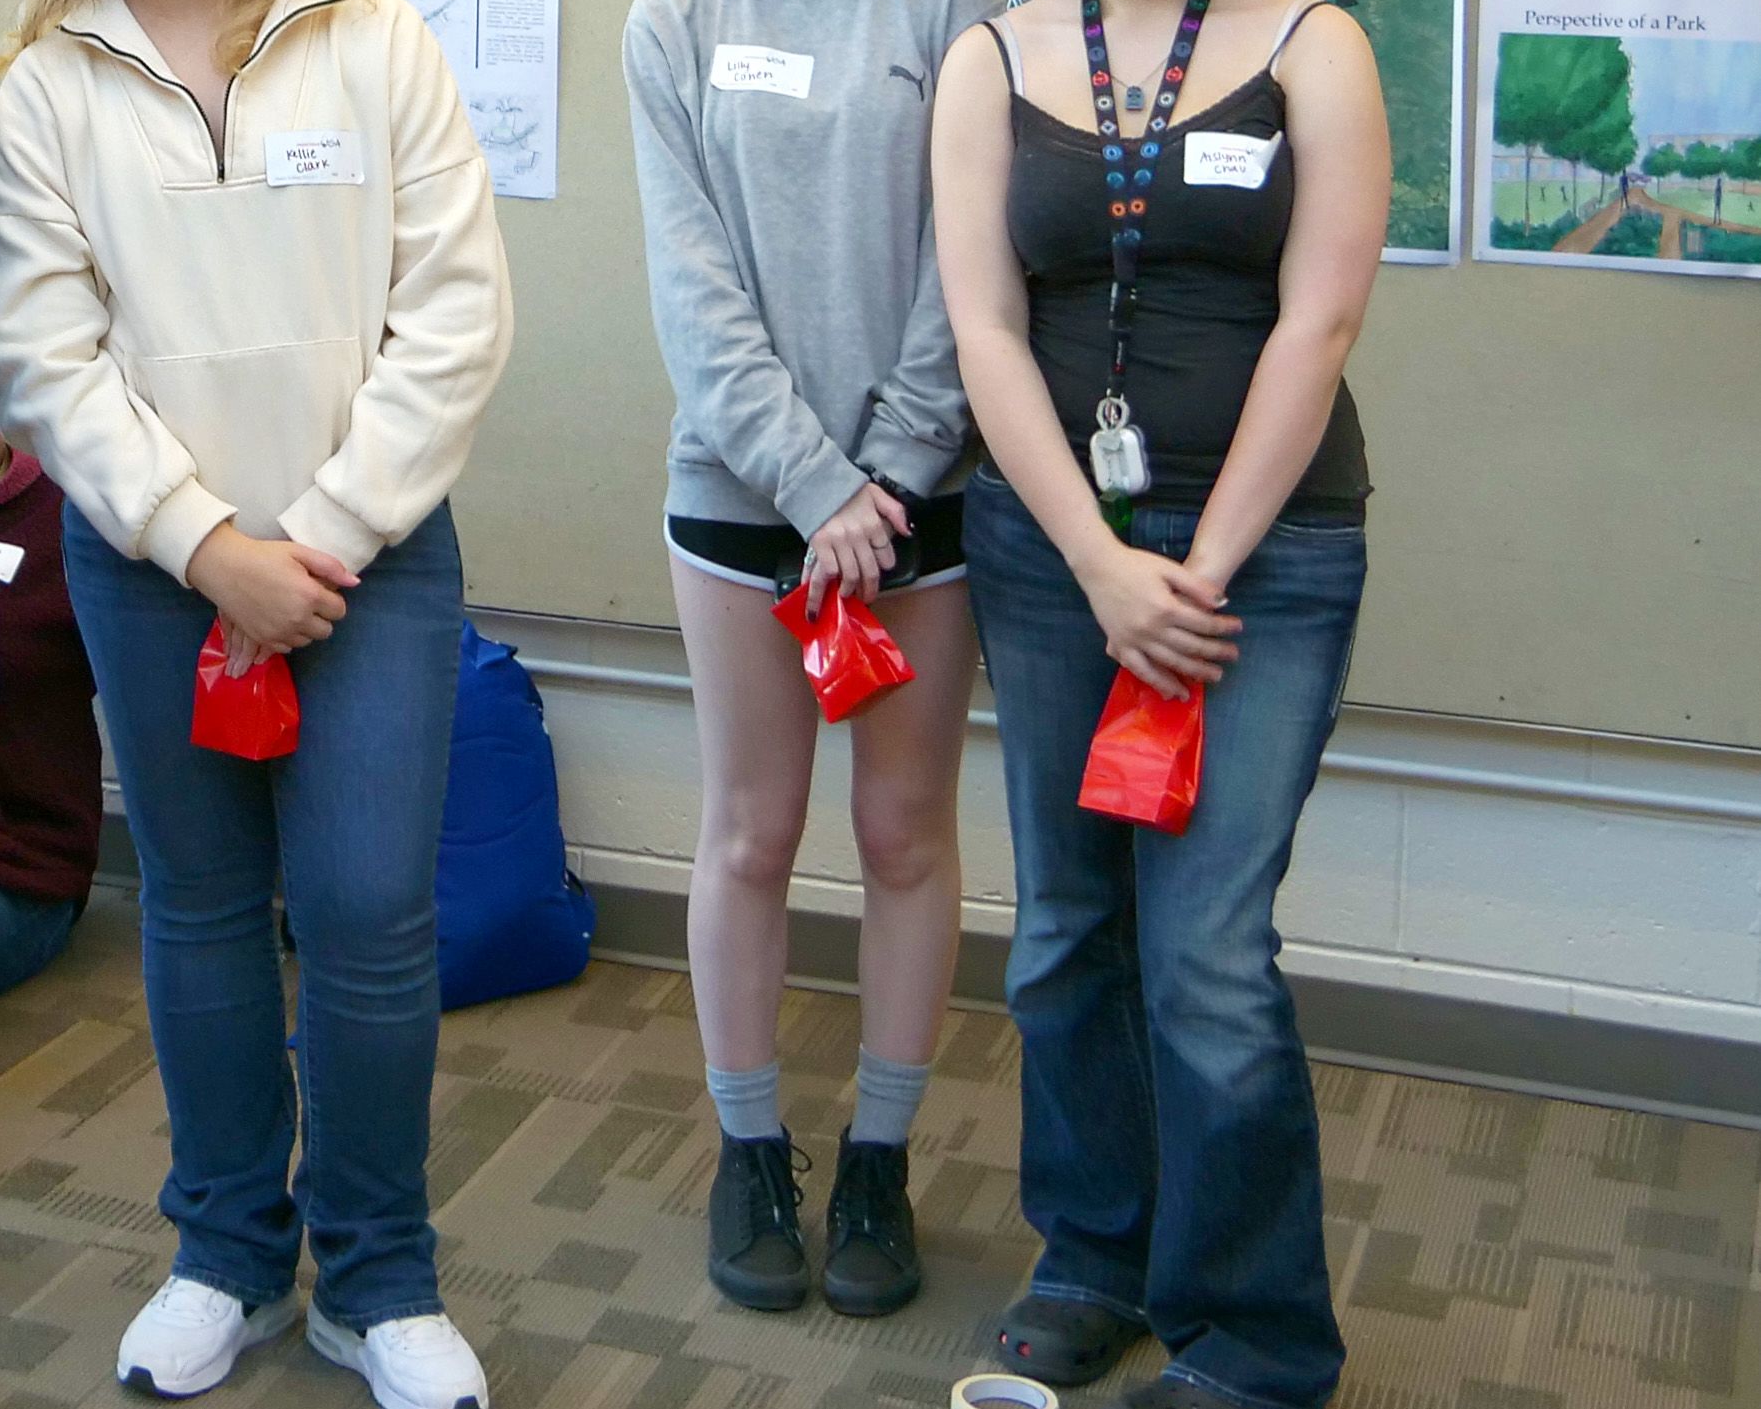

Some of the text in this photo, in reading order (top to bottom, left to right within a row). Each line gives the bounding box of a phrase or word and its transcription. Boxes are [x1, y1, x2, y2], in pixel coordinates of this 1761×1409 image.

[1524, 9, 1706, 32] Perspective of a Park
[296, 159, 331, 174] Clark
